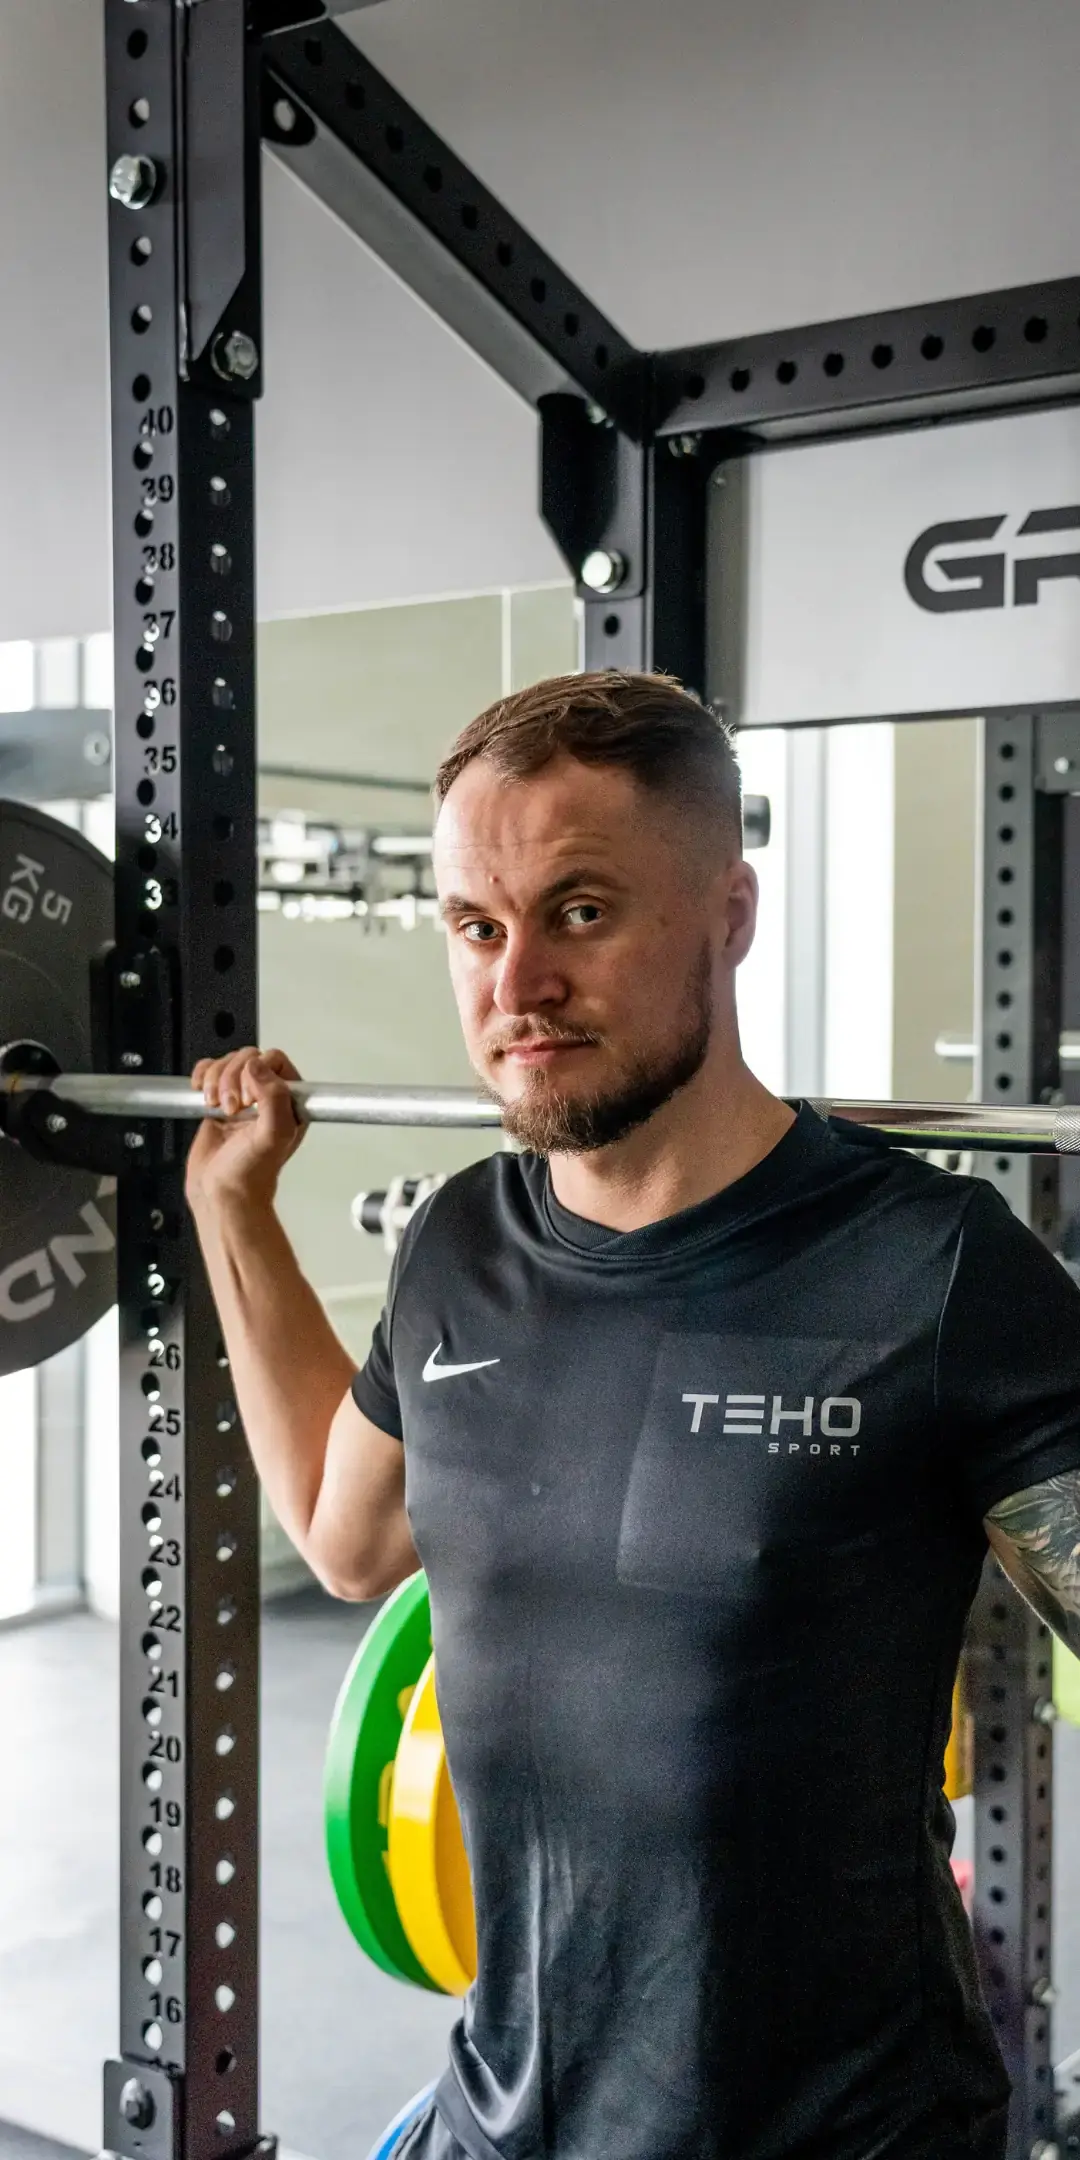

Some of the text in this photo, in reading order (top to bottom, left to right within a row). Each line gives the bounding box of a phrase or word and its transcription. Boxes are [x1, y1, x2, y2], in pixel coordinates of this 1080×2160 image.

[140, 405, 174, 436] 40
[141, 474, 174, 506] 39
[142, 542, 175, 574] 38
[143, 611, 176, 642] 37
[143, 677, 177, 710] 36
[144, 746, 177, 775] 35
[144, 812, 178, 844] 34
[2, 852, 46, 924] KG
[41, 889, 73, 926] 5
[148, 1338, 181, 1371] 26
[148, 1404, 181, 1436] 25
[681, 1393, 862, 1437] TEHO
[767, 1442, 861, 1456] SPORT
[148, 1469, 182, 1502] 24
[148, 1535, 181, 1567] 23
[149, 1600, 181, 1633] 22
[149, 1665, 179, 1698] 21
[149, 1731, 181, 1763] 20
[149, 1797, 181, 1828] 19
[149, 1862, 181, 1894] 18
[149, 1927, 181, 1958] 17
[150, 1991, 182, 2024] 16
